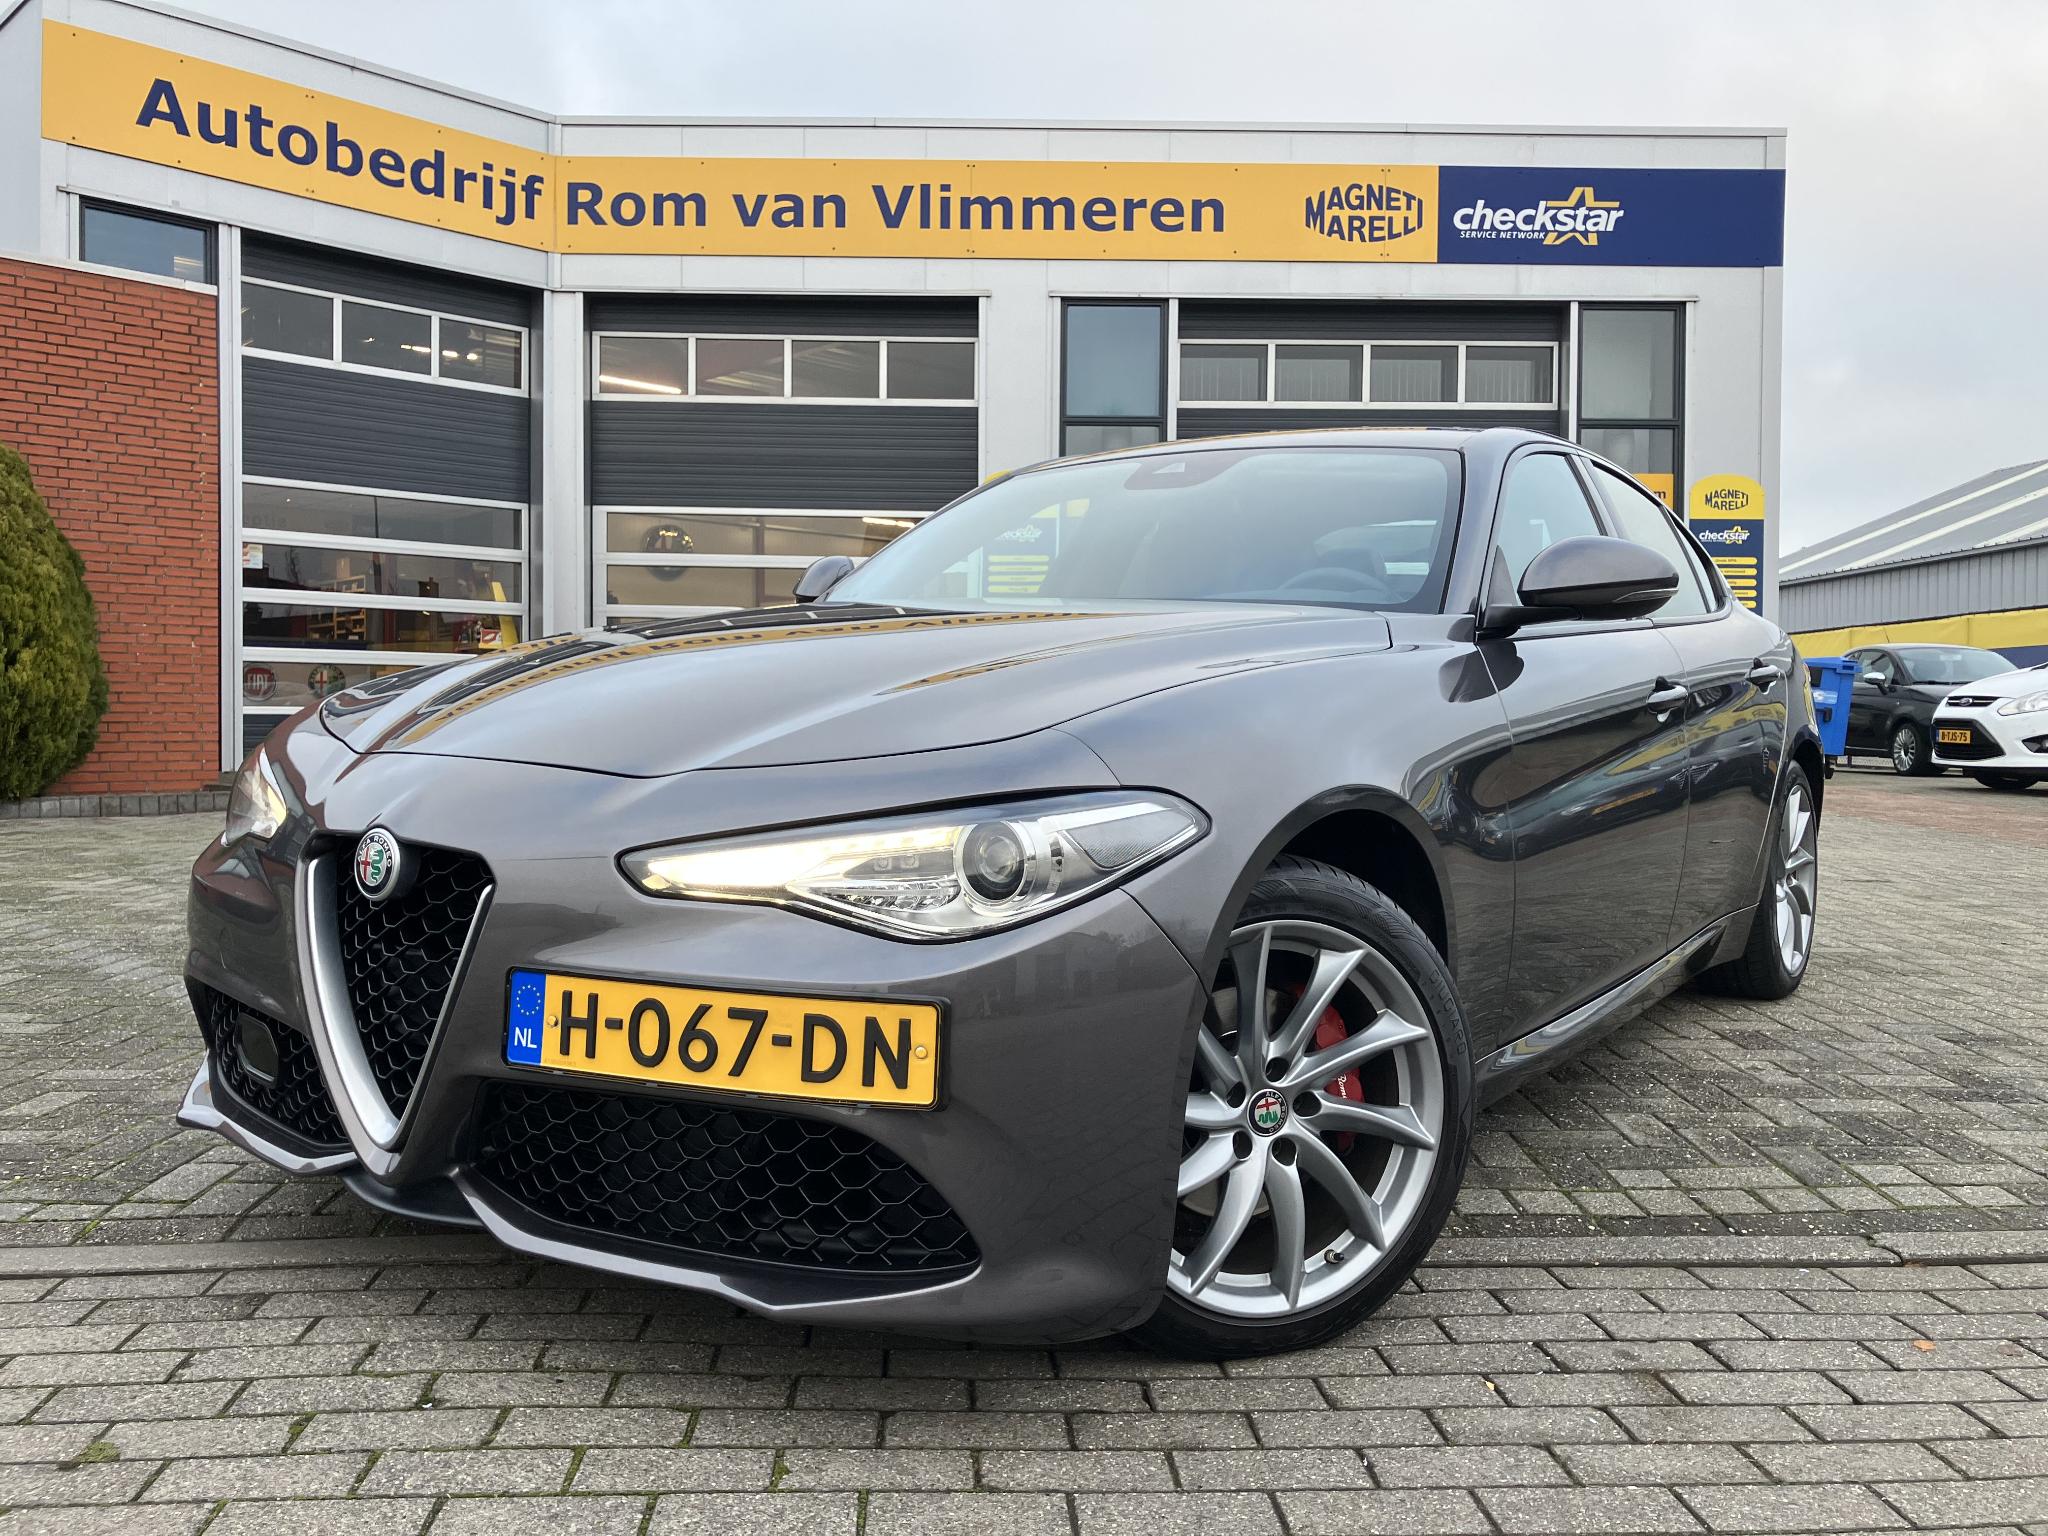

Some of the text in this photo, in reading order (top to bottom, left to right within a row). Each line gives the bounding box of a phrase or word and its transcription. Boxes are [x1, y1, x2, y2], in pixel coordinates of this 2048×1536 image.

[135, 77, 1225, 233] Autobedrijf Rom van Vlimmeren
[1304, 183, 1424, 220] MAGNETI
[1452, 199, 1625, 232] checkstar
[1304, 207, 1424, 243] MARELLI
[1460, 230, 1546, 240] SERVICE NETWORK
[1704, 488, 1749, 504] MAGNETI
[1698, 529, 1751, 541] checkstar
[247, 673, 270, 690] FIAT
[373, 835, 392, 867] ROMEO
[513, 1026, 538, 1050] NL
[558, 988, 912, 1090] H-067-DN
[1265, 1091, 1282, 1104] ALFA
